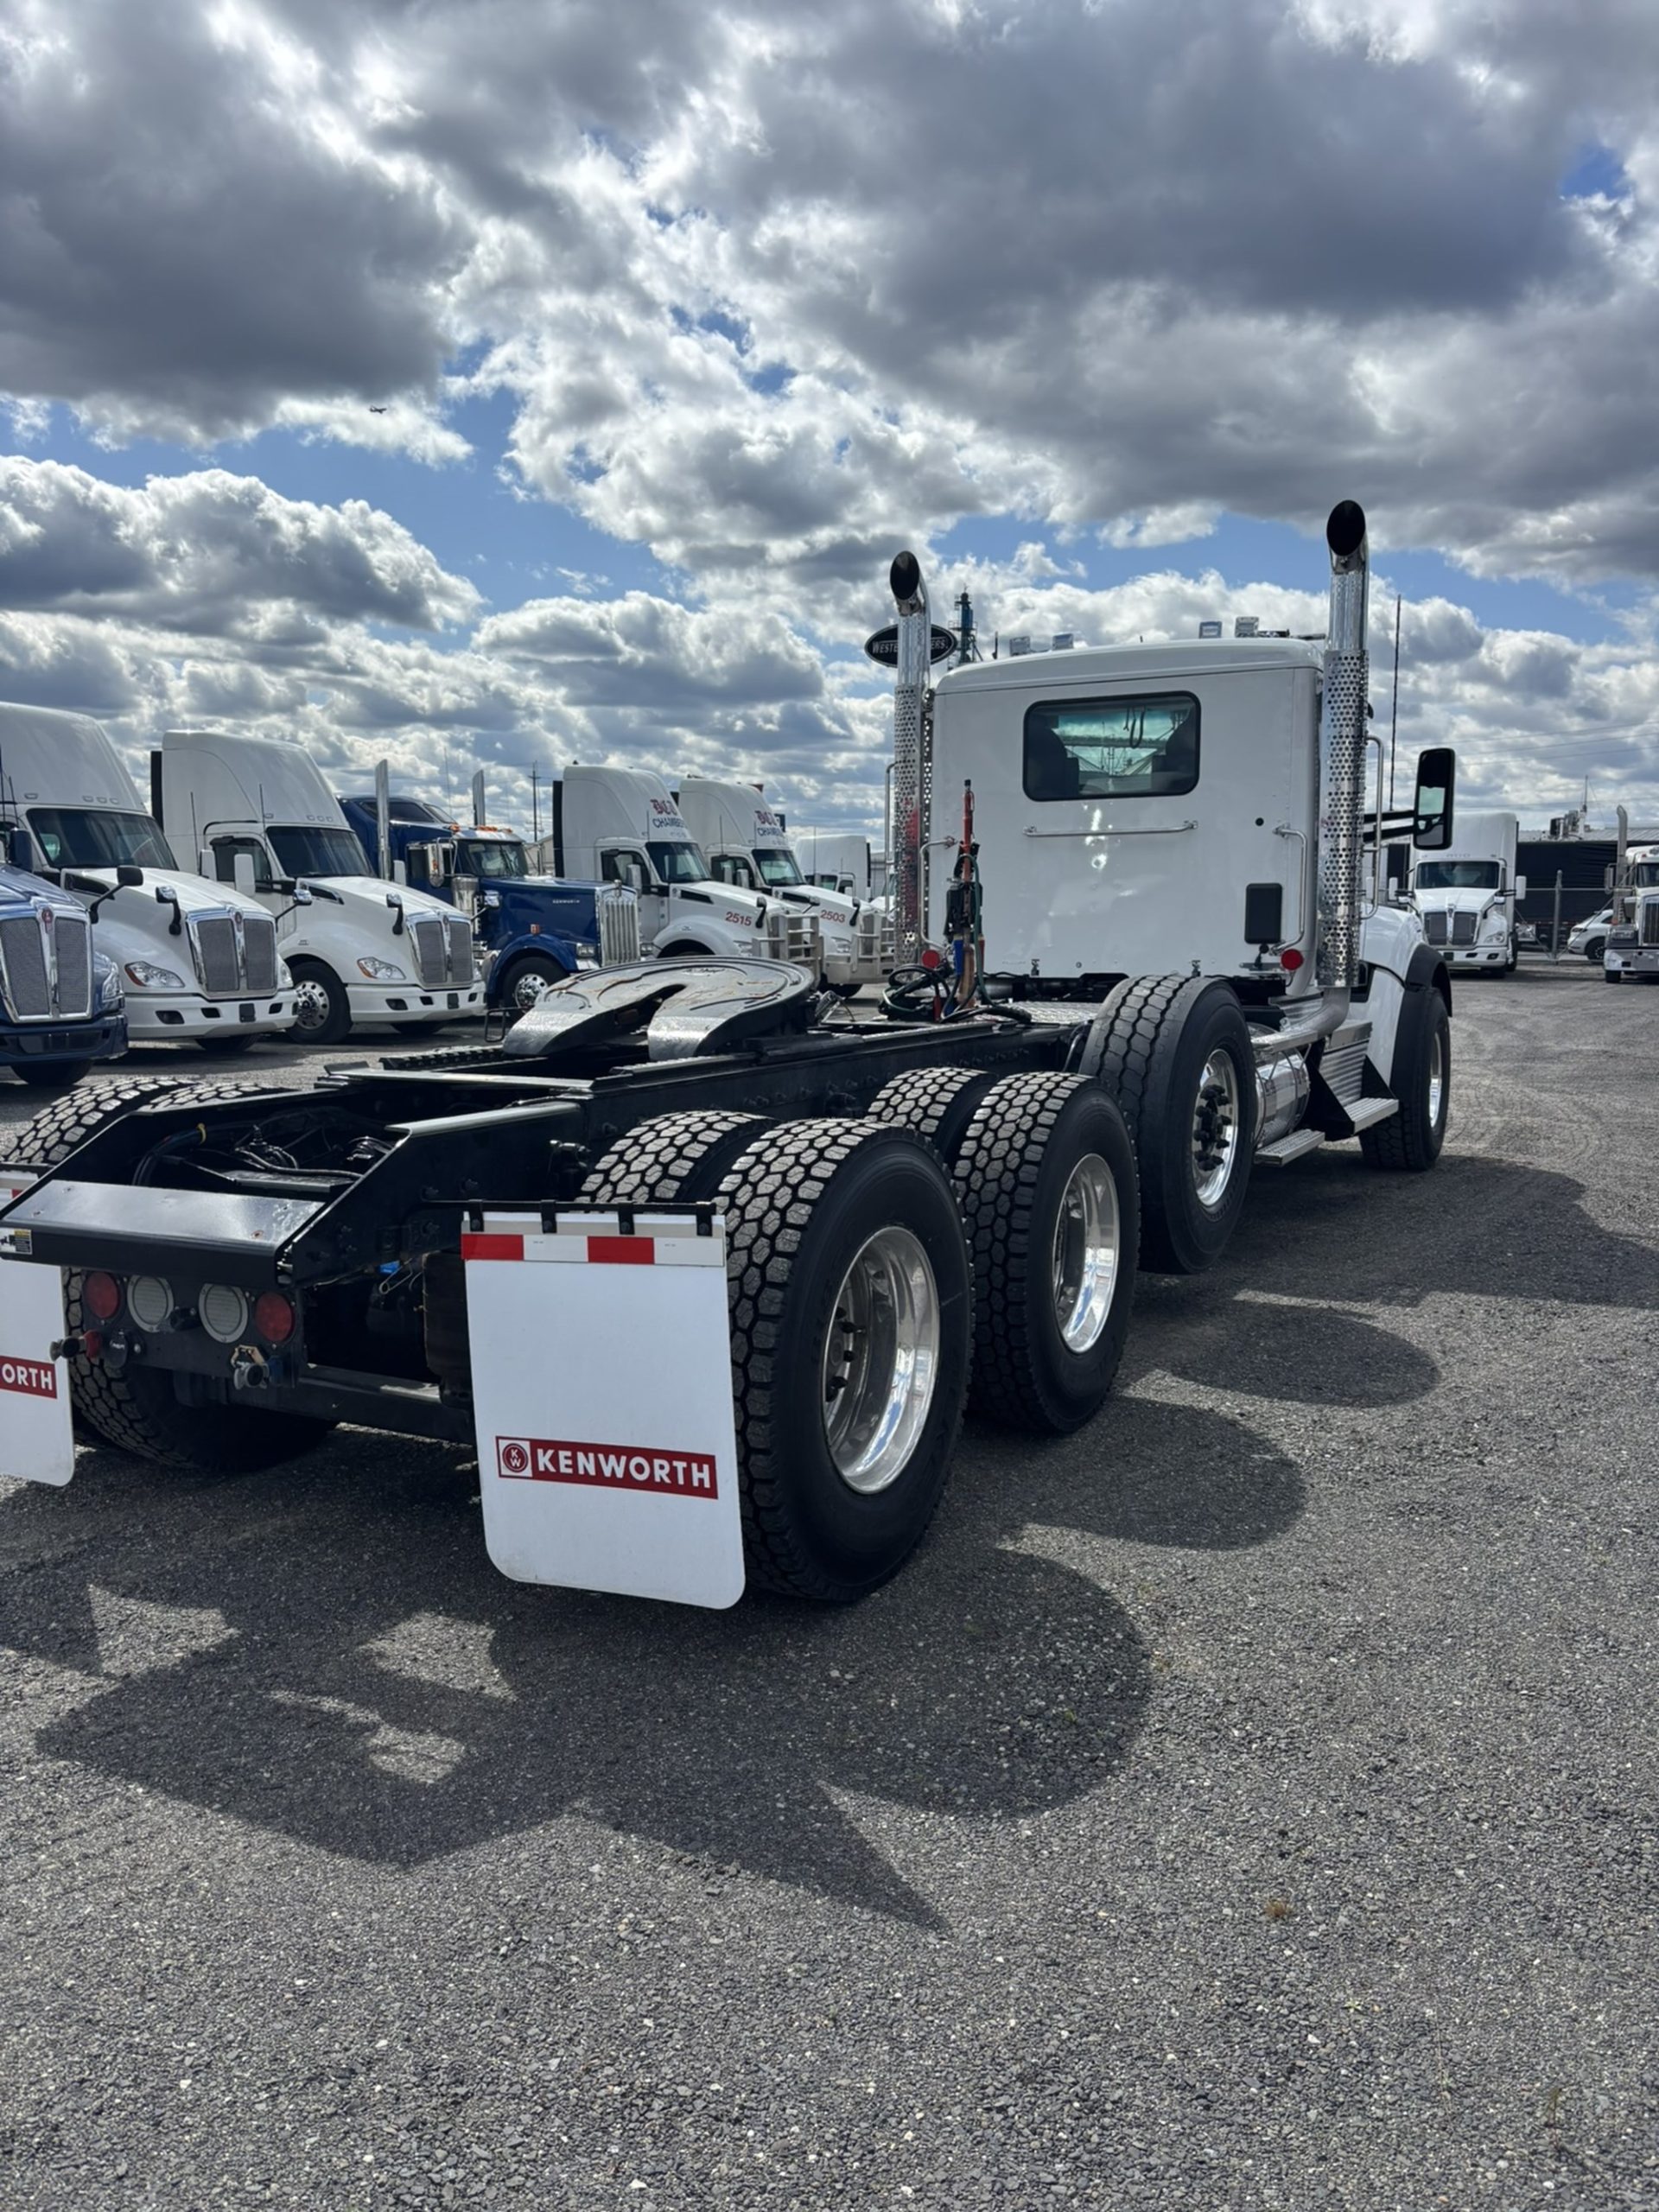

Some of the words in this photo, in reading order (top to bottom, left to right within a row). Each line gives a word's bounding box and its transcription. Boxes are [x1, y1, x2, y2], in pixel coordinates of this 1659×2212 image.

[872, 641, 899, 654] WESTE
[726, 912, 752, 926] 2515
[820, 910, 846, 923] 2503
[537, 1448, 710, 1489] KENWORTH
